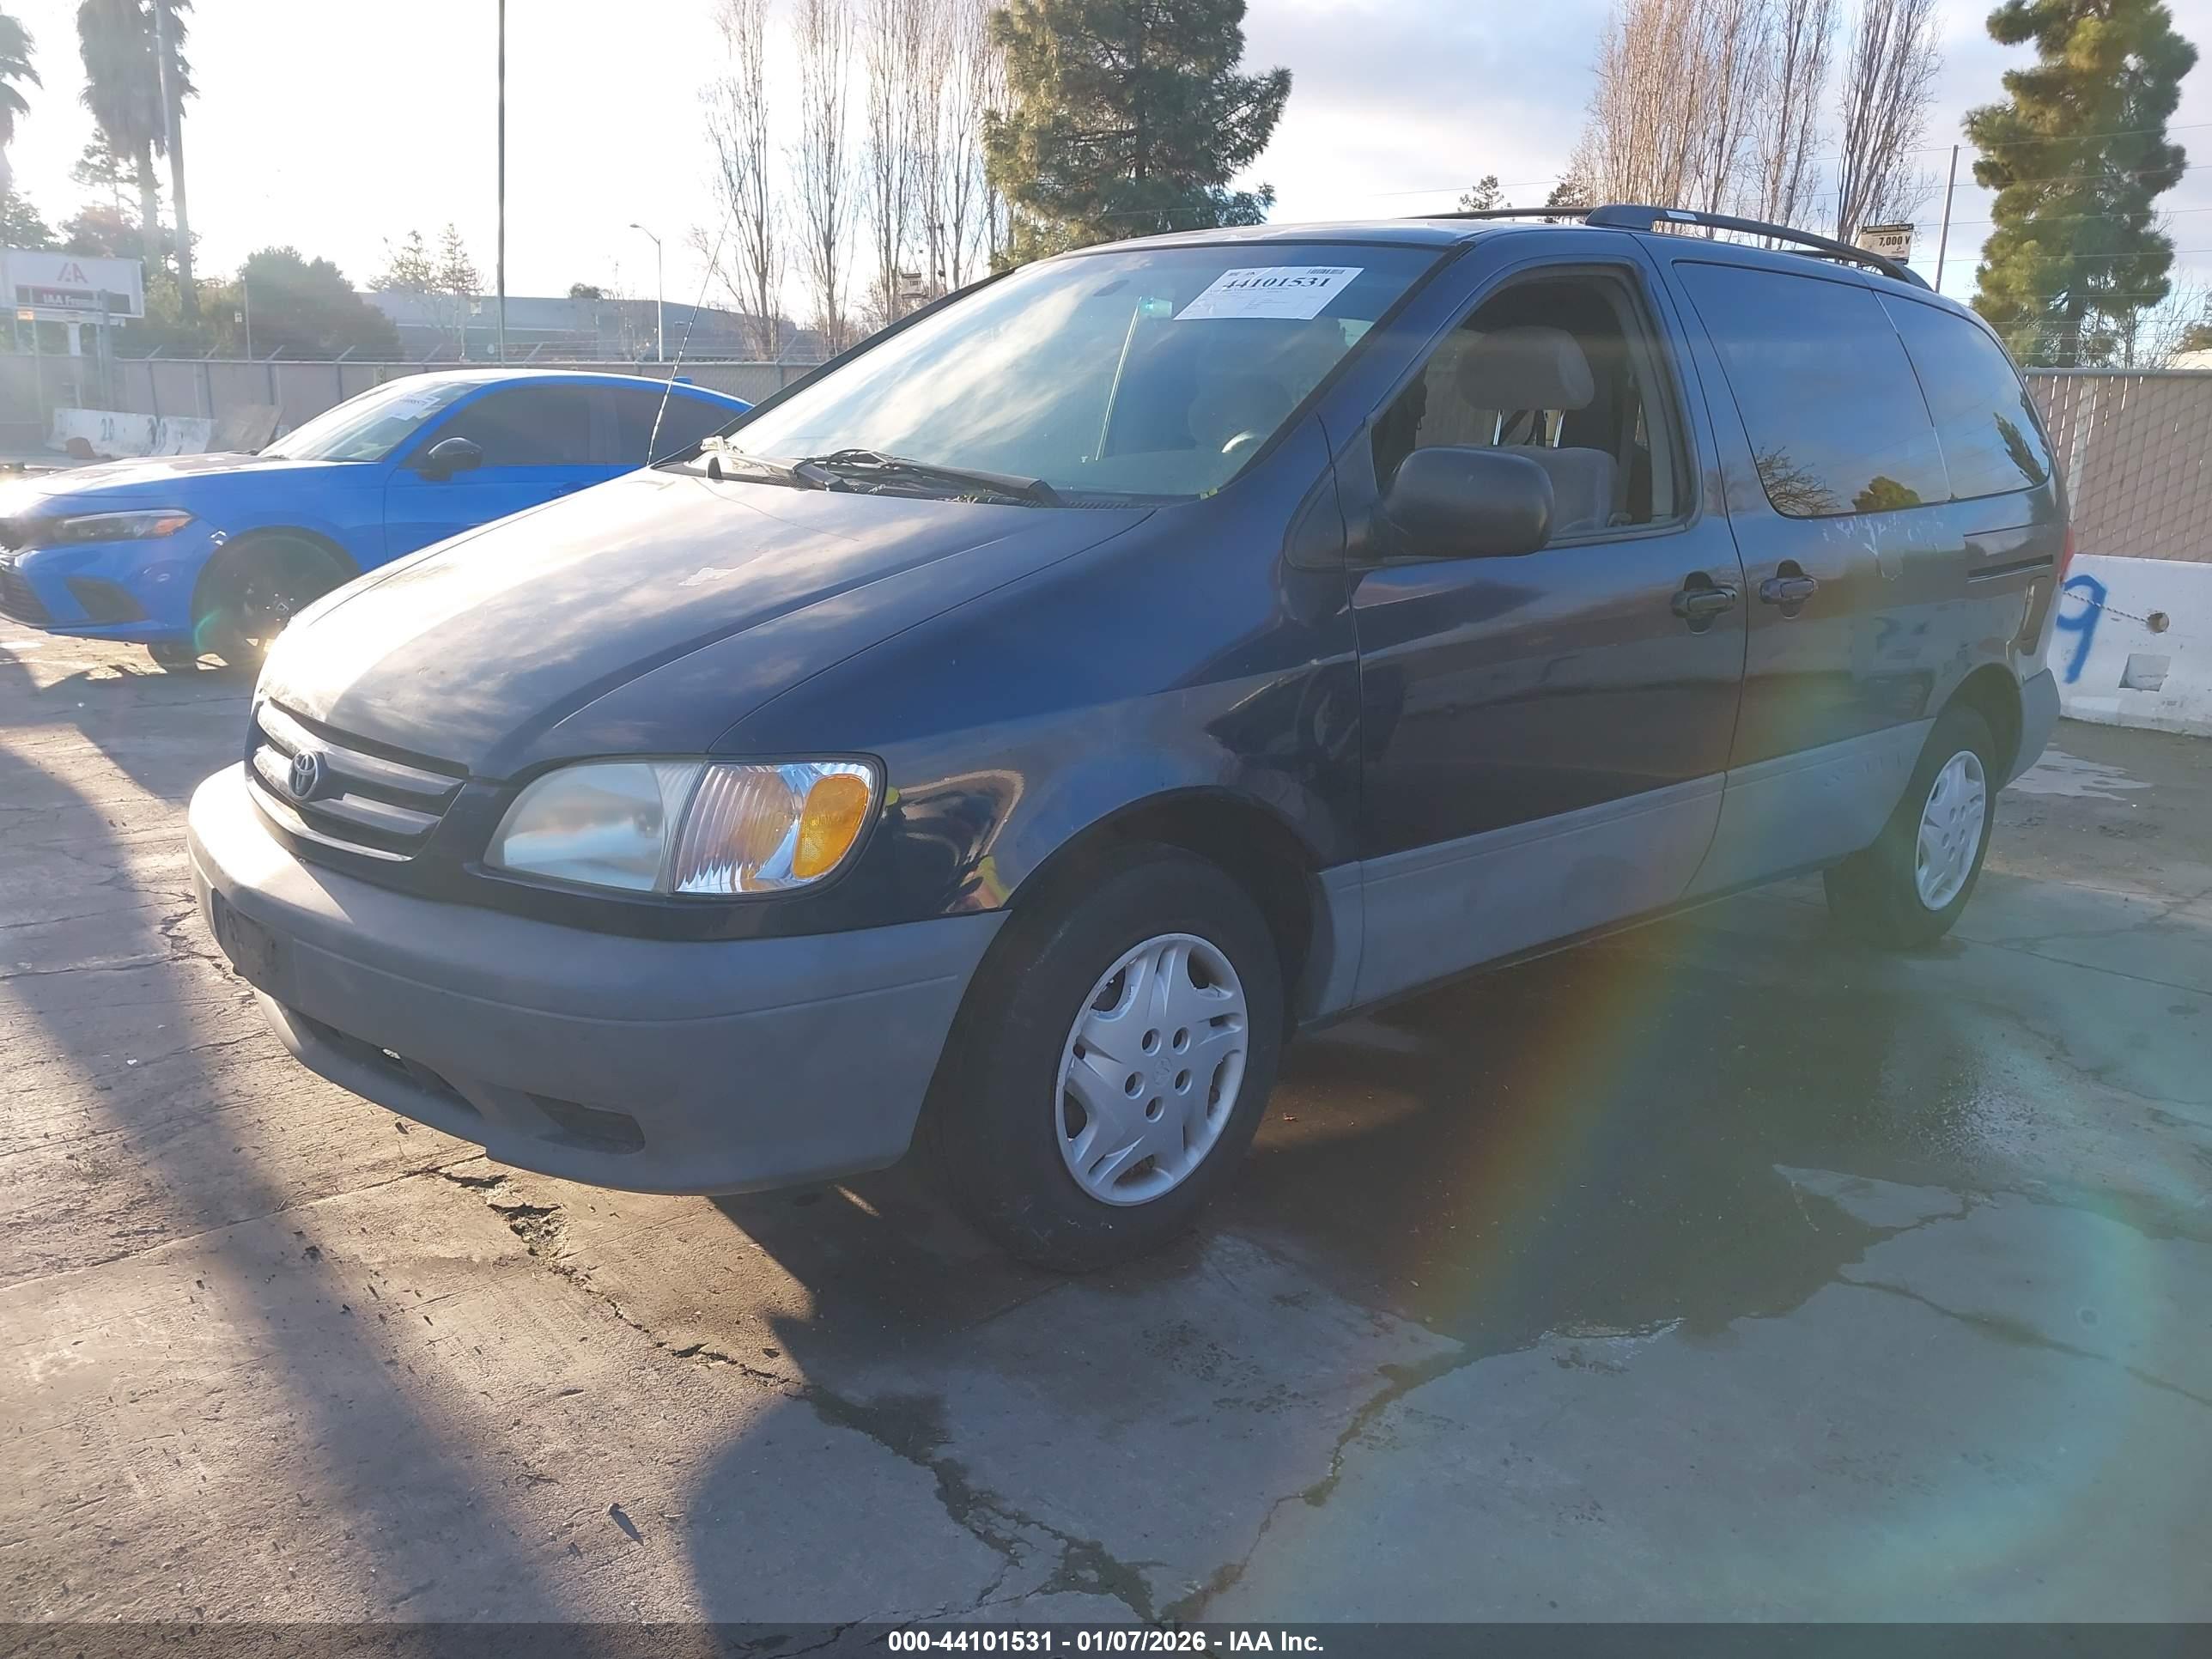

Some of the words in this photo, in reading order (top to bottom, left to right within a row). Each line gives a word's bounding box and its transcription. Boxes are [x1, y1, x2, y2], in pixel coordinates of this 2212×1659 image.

[1879, 236, 1902, 247] 7,000
[1223, 277, 1331, 289] 44101531
[2056, 574, 2108, 684] 9
